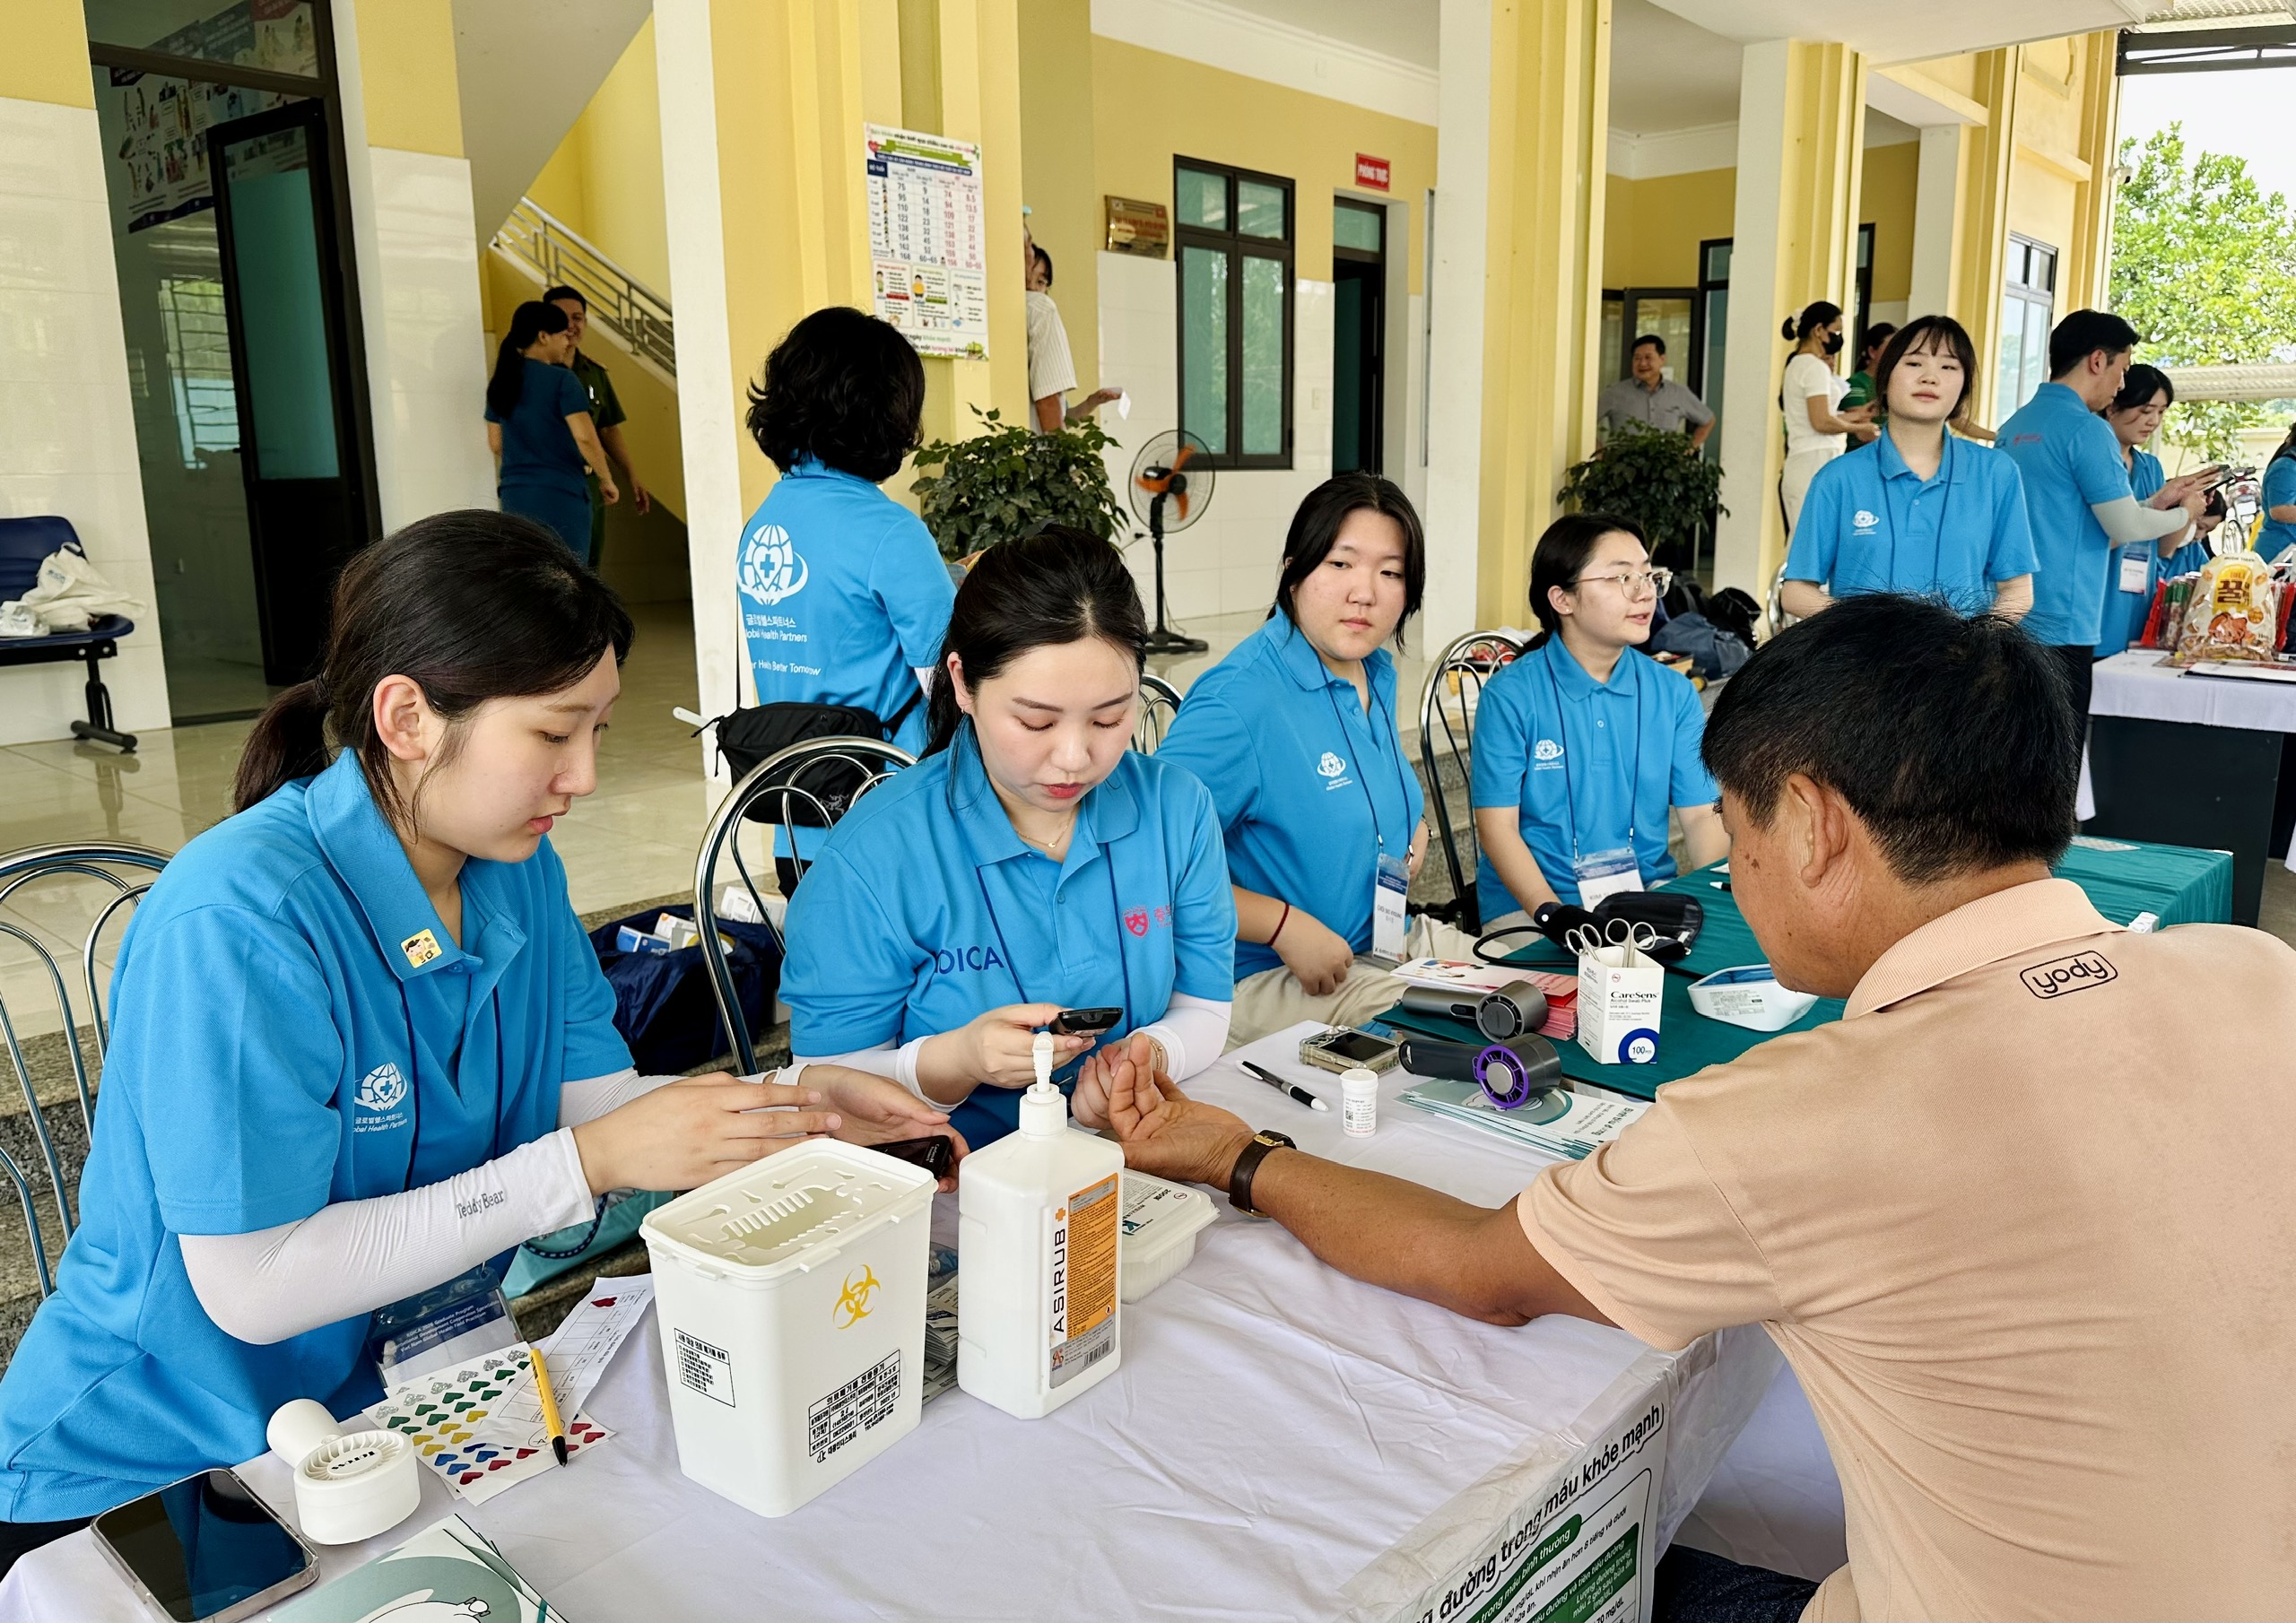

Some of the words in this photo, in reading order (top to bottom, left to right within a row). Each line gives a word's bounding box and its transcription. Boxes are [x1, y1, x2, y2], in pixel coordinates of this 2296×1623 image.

[779, 630, 807, 643] Partners
[934, 945, 1004, 975] OICA
[2032, 959, 2108, 994] yody
[1611, 991, 1657, 999] CareSens
[1632, 1046, 1646, 1055] 100
[368, 1124, 389, 1133] Health
[457, 1199, 483, 1219] Teddy
[482, 1189, 504, 1210] Bear
[1053, 1228, 1065, 1333] ASIRUB
[419, 1321, 449, 1337] Development
[449, 1309, 476, 1324] Cooperation
[434, 1314, 455, 1325] Graduate
[1439, 1554, 1497, 1619] đường
[1501, 1508, 1543, 1562] trong
[1544, 1476, 1578, 1517] máu
[1583, 1443, 1619, 1487] khỏe
[1622, 1405, 1659, 1453] mạnh
[1481, 1595, 1503, 1622] trong
[1504, 1575, 1521, 1601] máu
[1521, 1556, 1538, 1579] bình
[1539, 1529, 1570, 1559] thường
[1535, 1576, 1546, 1592] khi
[1546, 1566, 1561, 1583] nhịn
[1561, 1558, 1570, 1570] ăn
[1570, 1547, 1583, 1562] hơn
[1545, 1591, 1569, 1616] đường
[1569, 1584, 1578, 1595] và
[1604, 1540, 1625, 1563] đường
[1572, 1601, 1587, 1619] máu
[1587, 1596, 1592, 1606] 2
